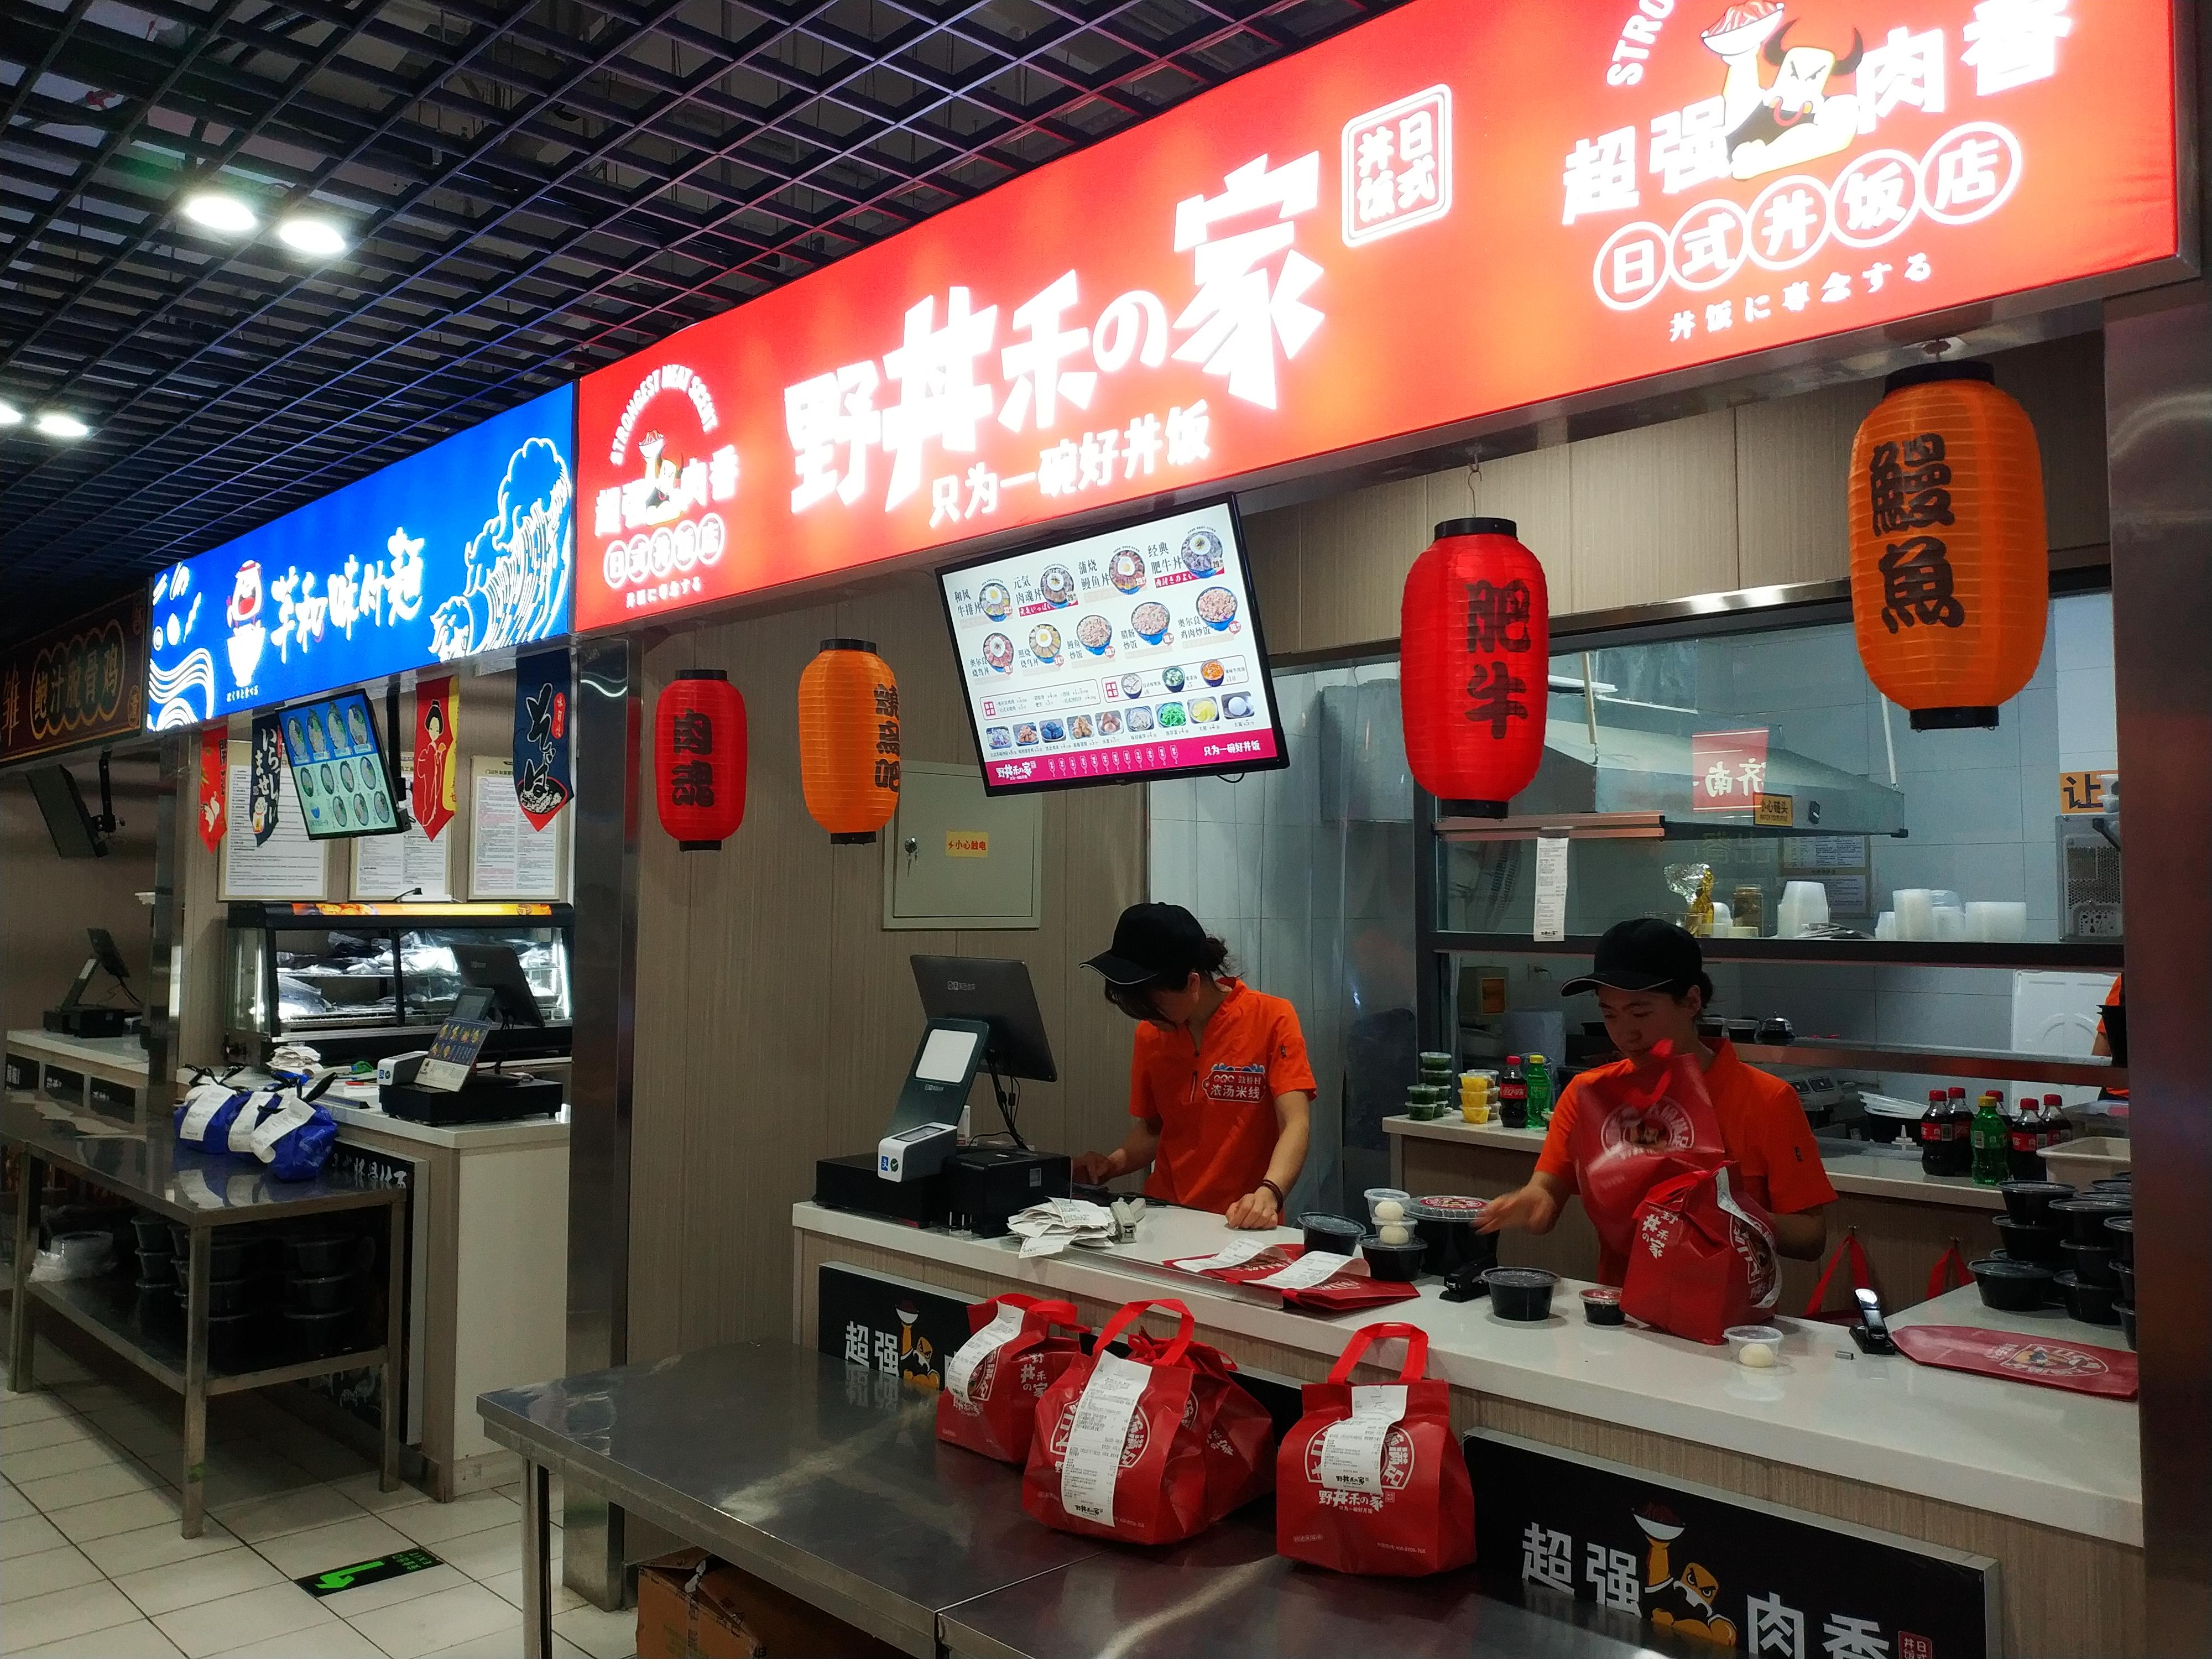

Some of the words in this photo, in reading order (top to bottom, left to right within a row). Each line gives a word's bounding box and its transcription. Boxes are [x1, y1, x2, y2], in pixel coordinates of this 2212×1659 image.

[1562, 95, 1731, 225] 超强
[1147, 541, 1169, 558] 经典
[1078, 559, 1098, 575] 蒲烧
[1150, 555, 1183, 575] 肥牛丼
[1081, 572, 1109, 591] 鳗鱼丼
[954, 588, 971, 602] 和风
[957, 601, 982, 618] 牛排丼
[1123, 640, 1138, 651] 炒饭
[1070, 650, 1083, 660] 炒饭
[1464, 578, 1532, 740] 肥牛
[2063, 773, 2104, 809] 让
[955, 840, 987, 851] 小心触电
[1210, 1083, 1260, 1100] 浓汤米线
[845, 1320, 900, 1378] 超强
[1522, 1522, 1642, 1618] 超强
